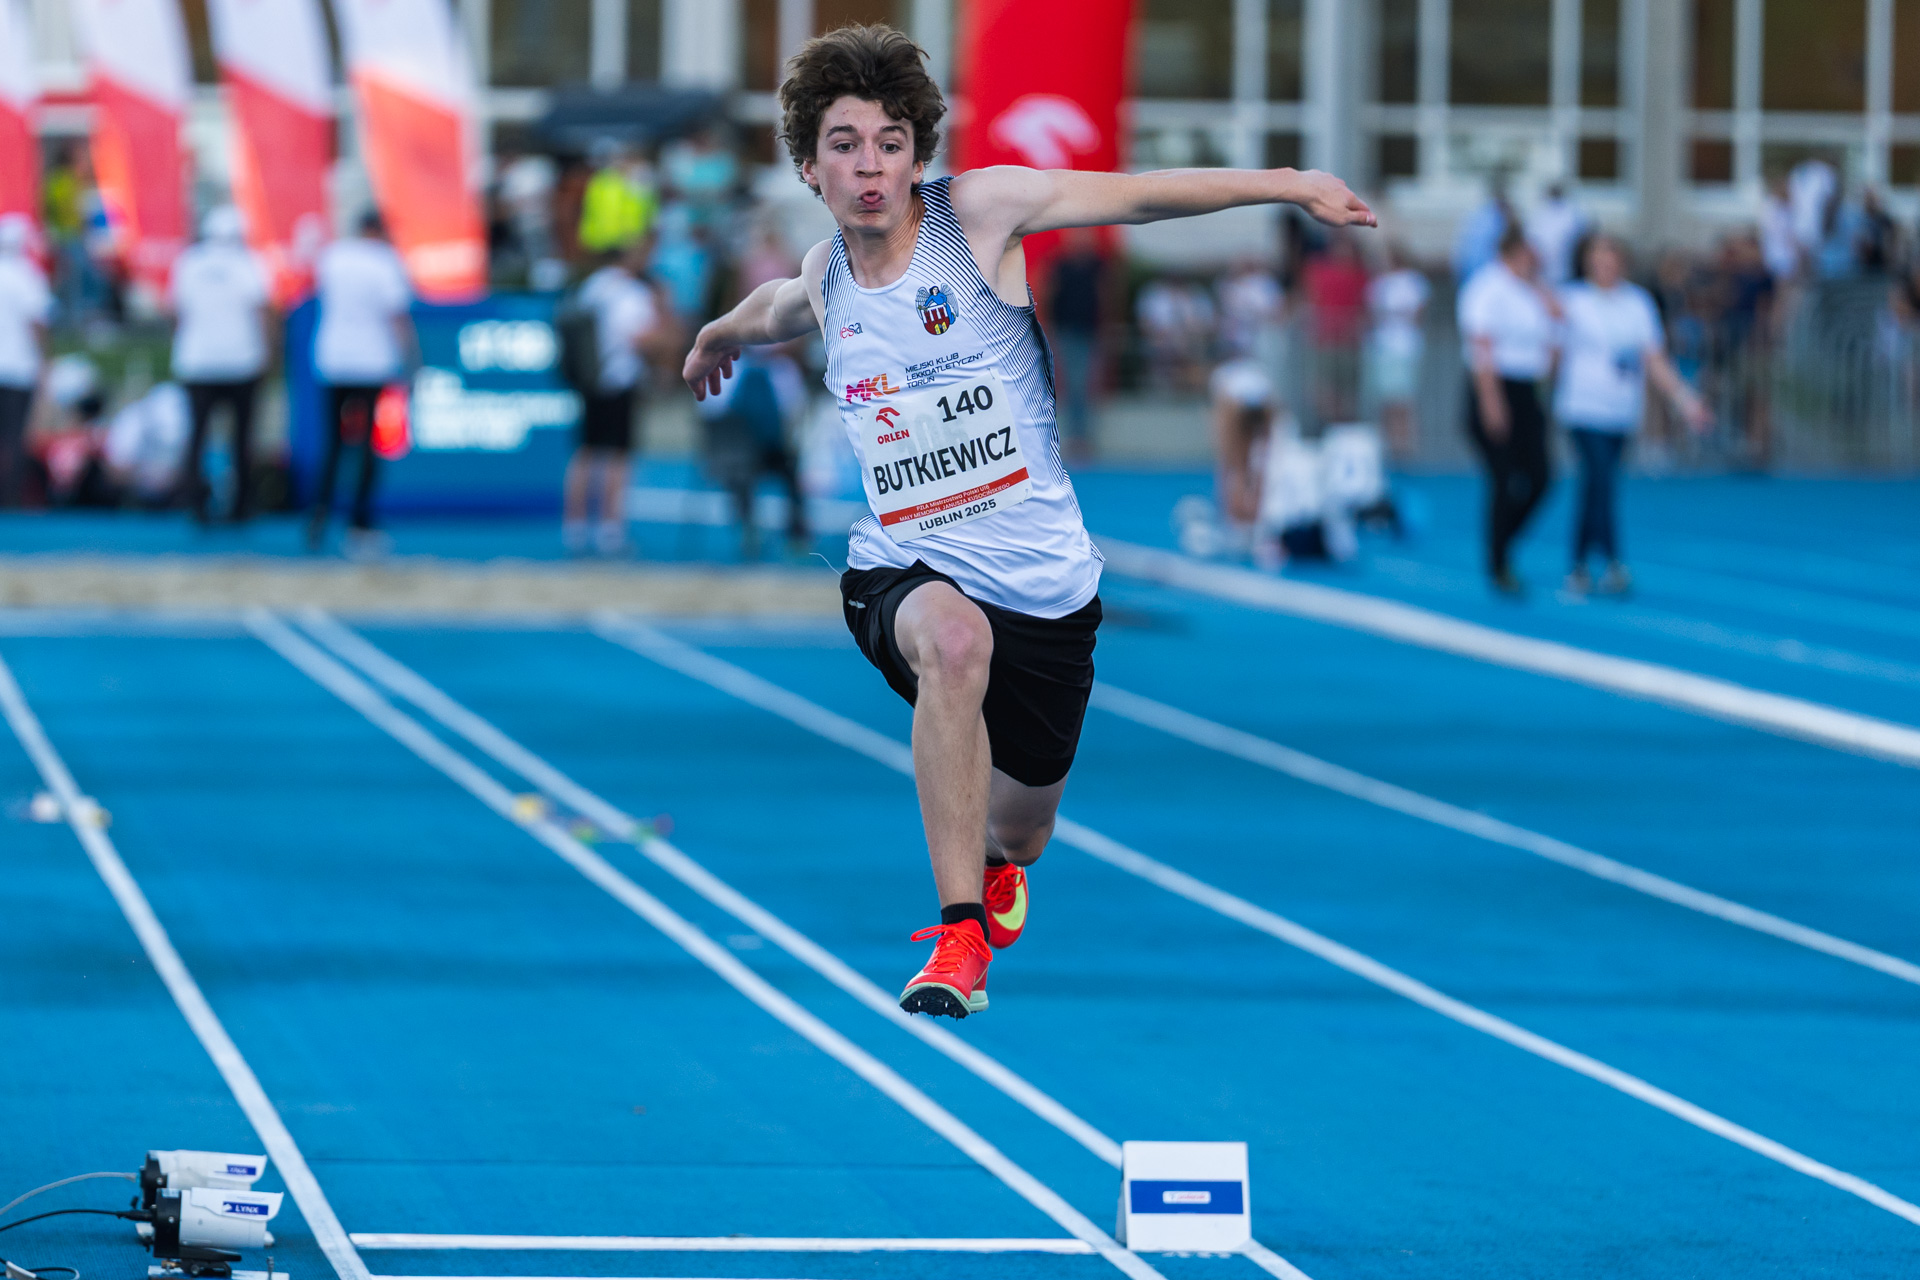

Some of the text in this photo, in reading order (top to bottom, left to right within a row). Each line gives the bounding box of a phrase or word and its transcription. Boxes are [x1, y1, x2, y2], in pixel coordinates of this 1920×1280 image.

[840, 322, 863, 339] esa
[905, 352, 959, 374] MIEJSKI KLUB
[906, 351, 984, 381] LEKKOATLETYCZNY
[845, 373, 900, 404] MKL
[936, 385, 993, 423] 140
[877, 429, 910, 445] ORLEN
[873, 426, 1017, 496] BUTKIEWICZ
[899, 513, 913, 521] MAŁY
[942, 498, 967, 510] JANUSZA
[916, 484, 990, 511] PZLA Mistrzostwa Polski U16
[919, 499, 997, 531] LUBLIN 2025
[235, 1204, 259, 1214] LYNX
